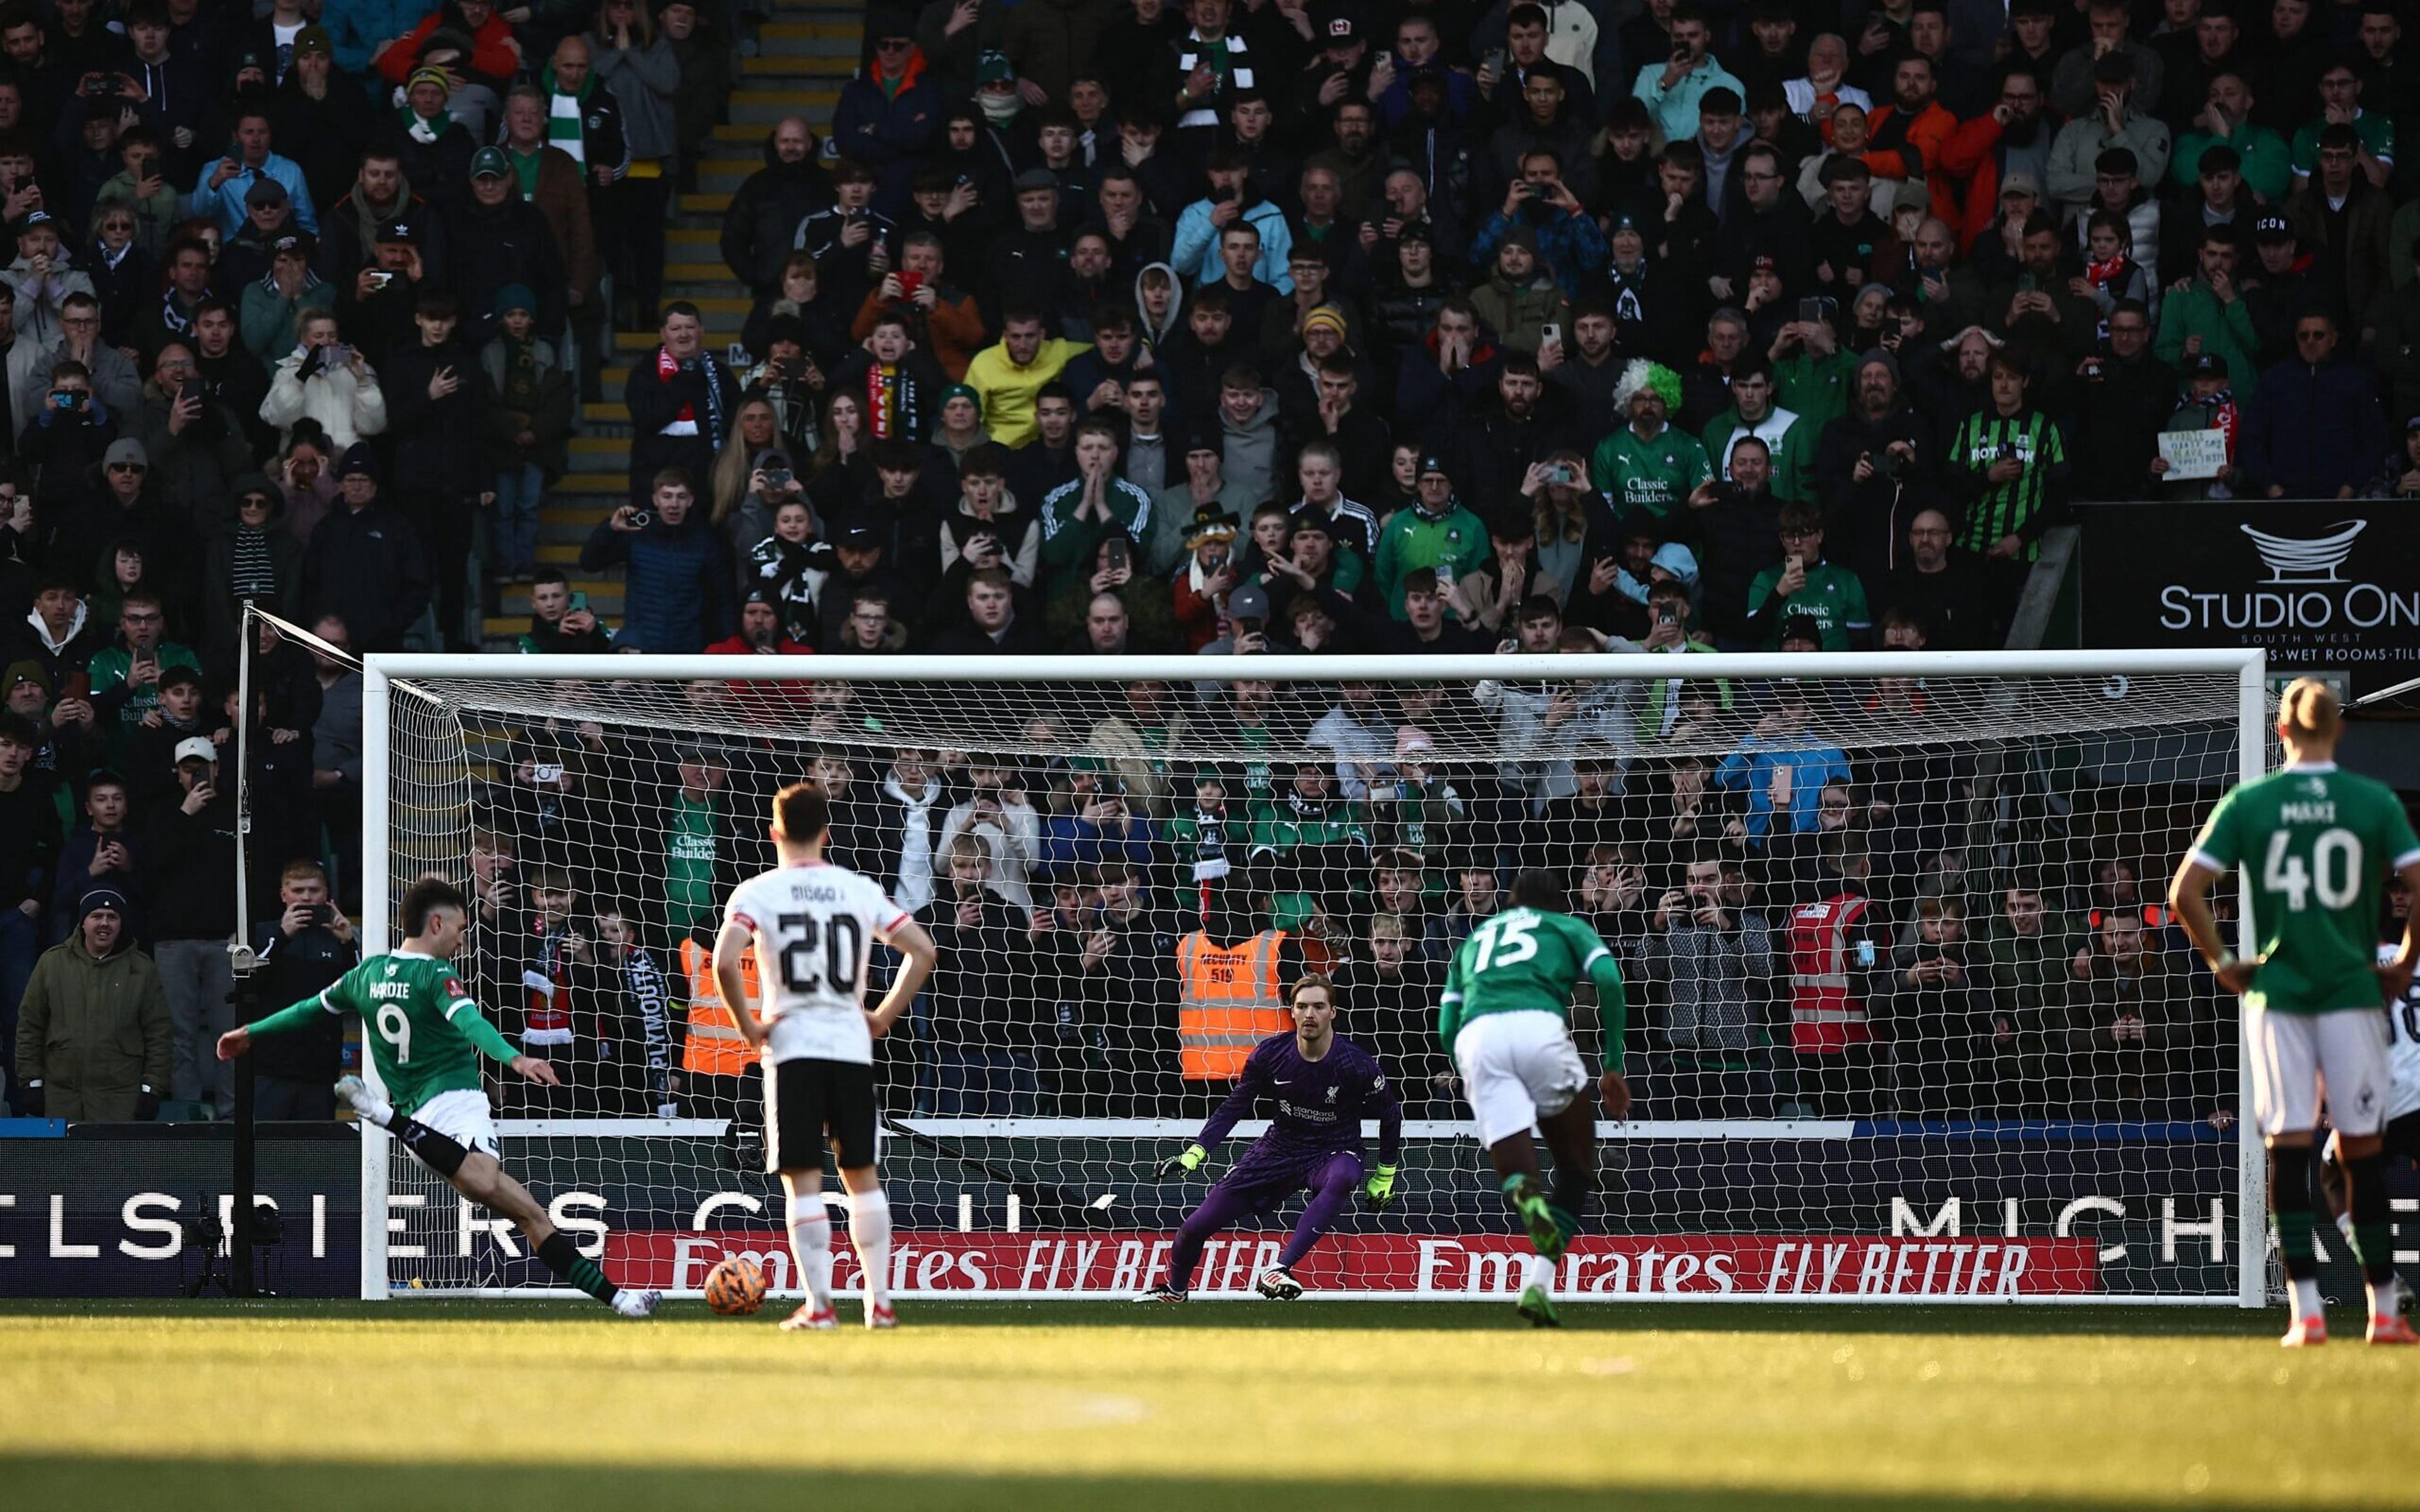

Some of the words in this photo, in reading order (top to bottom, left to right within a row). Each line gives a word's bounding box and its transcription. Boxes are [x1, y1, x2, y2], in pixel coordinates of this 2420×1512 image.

[2257, 217, 2285, 231] ICON
[1627, 476, 1668, 490] Classic
[1624, 490, 1674, 503] Builders
[1787, 603, 1829, 617] Classic
[2160, 584, 2332, 630] STUDIO
[2241, 634, 2301, 644] SOUTH
[2315, 634, 2361, 644] WEST
[676, 835, 716, 847] Classic
[672, 847, 716, 859] Builder
[2262, 827, 2363, 912] 40
[1473, 913, 1541, 973] 15
[779, 914, 860, 993] 20
[1201, 953, 1248, 966] SECURITY
[1211, 968, 1234, 983] 519
[369, 982, 410, 1000] HARDIE
[376, 1002, 411, 1064] 9
[1293, 1105, 1335, 1118] standard
[1293, 1111, 1337, 1123] chartered
[1021, 1240, 1102, 1291] FLY
[1110, 1240, 1281, 1292] BETER
[1767, 1243, 1848, 1295] FLY
[1857, 1243, 2029, 1295] BETTER
